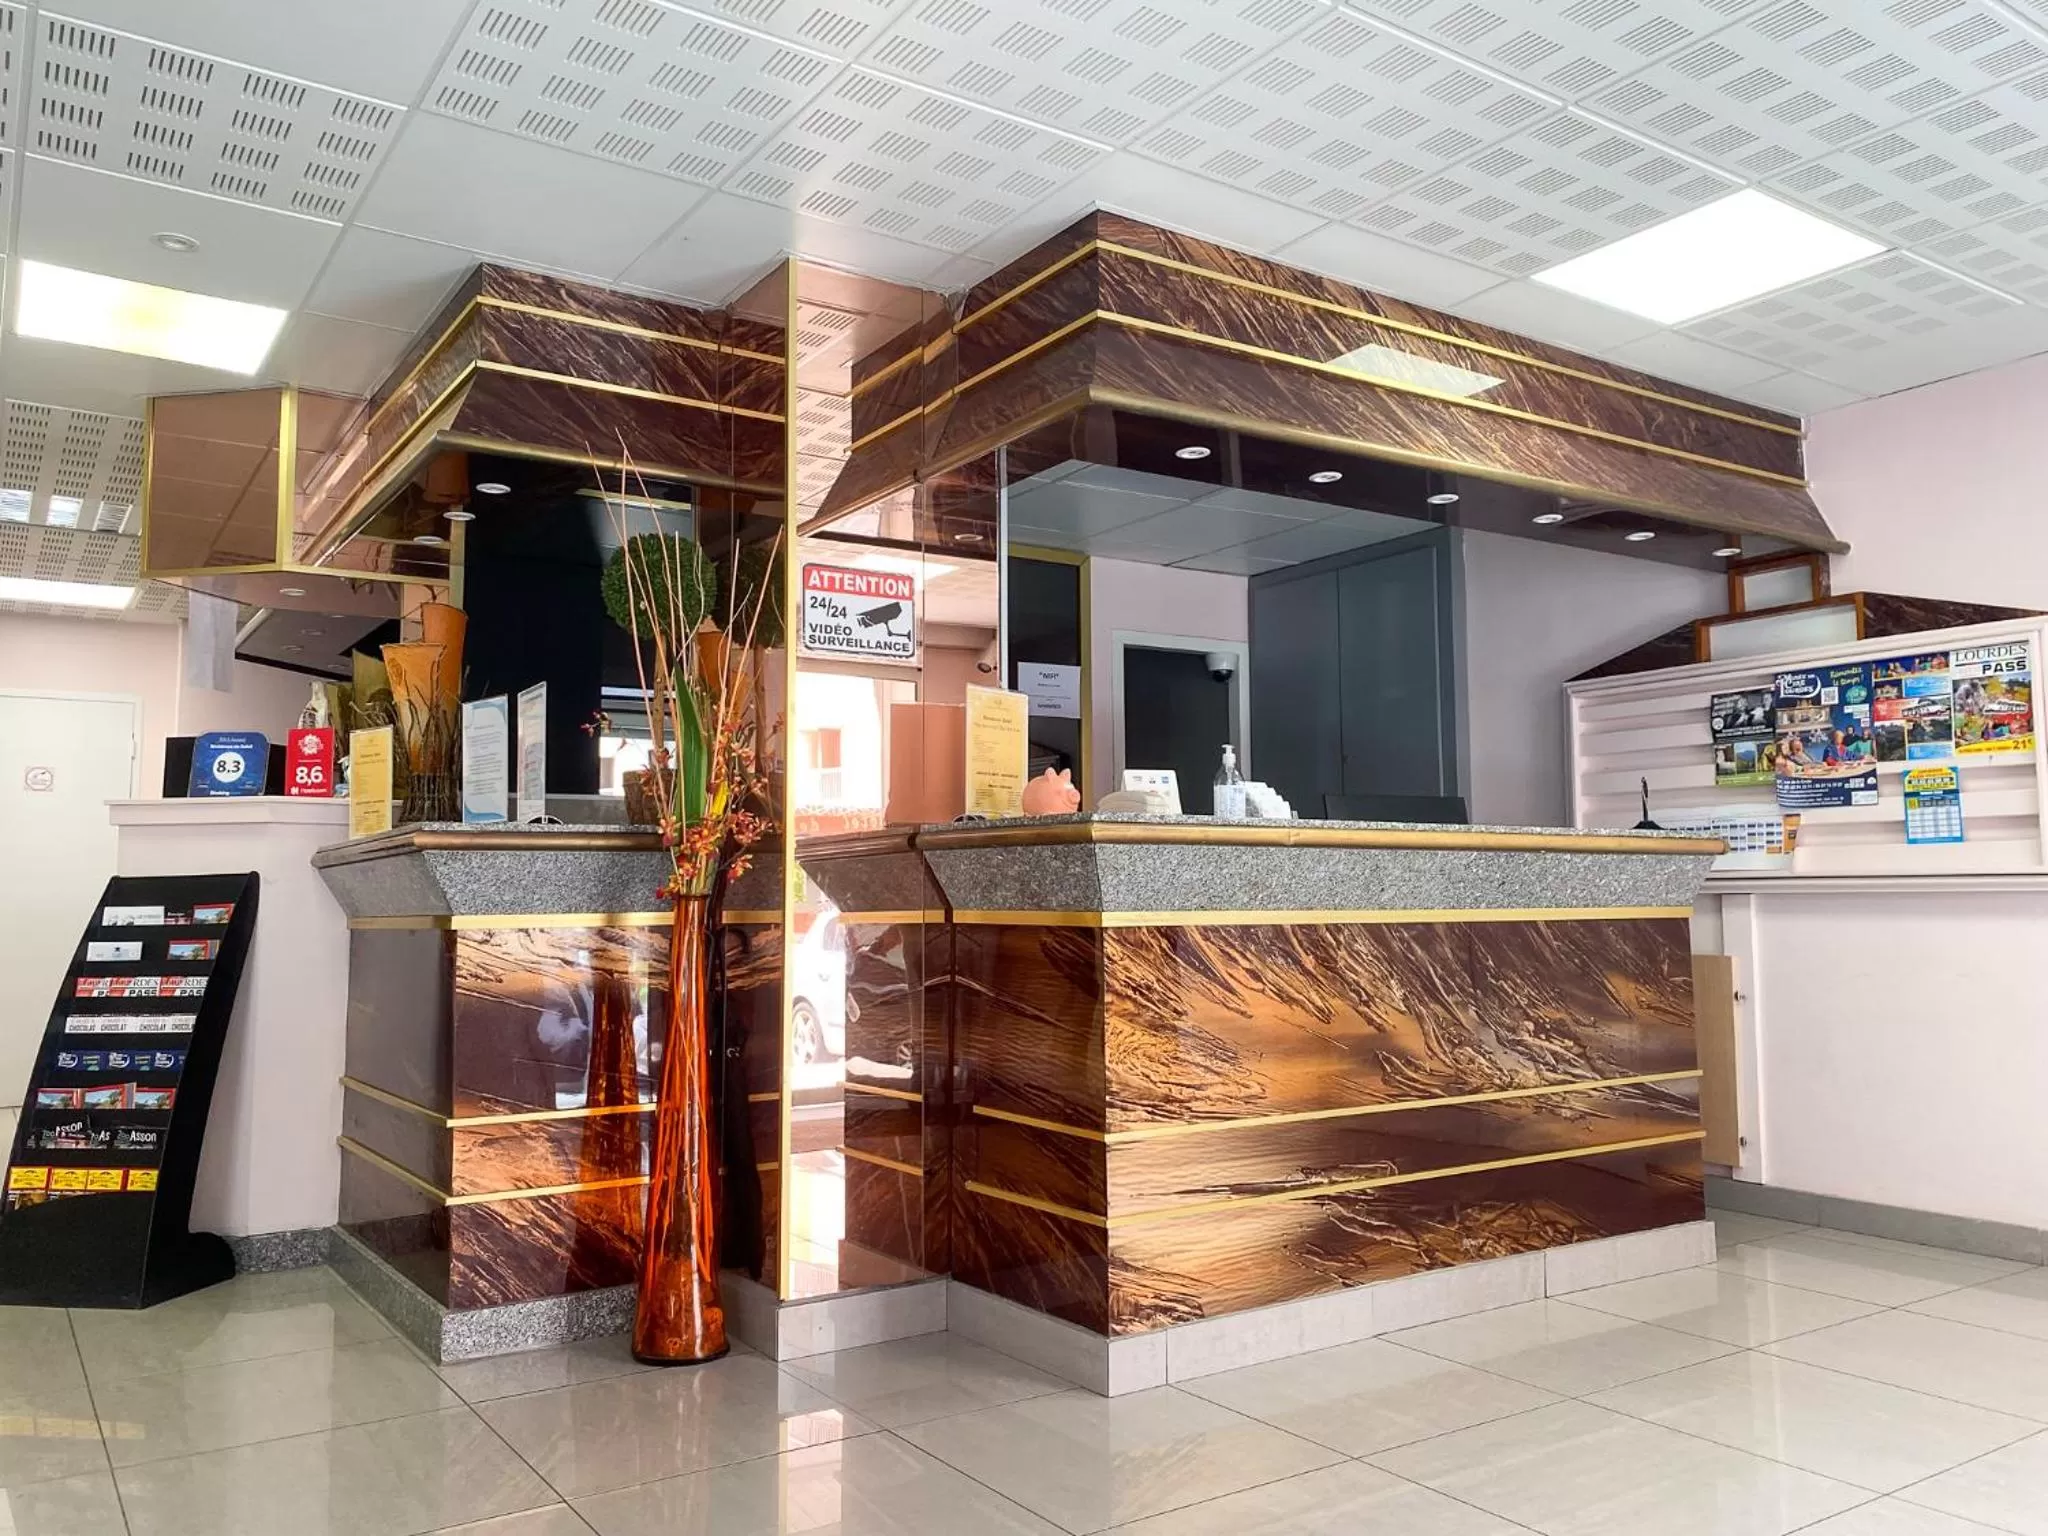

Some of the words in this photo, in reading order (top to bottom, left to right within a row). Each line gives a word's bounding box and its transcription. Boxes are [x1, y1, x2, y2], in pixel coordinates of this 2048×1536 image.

[808, 569, 910, 597] ATTENTION
[810, 596, 847, 619] 24/24
[808, 621, 853, 636] VIDÉO
[808, 634, 910, 652] SURVEILLANCE
[1955, 643, 2027, 662] LOURDES
[1982, 660, 2027, 675] PASS
[216, 760, 241, 773] 8.3
[295, 765, 323, 785] 8,6
[129, 1130, 157, 1143] Asson
